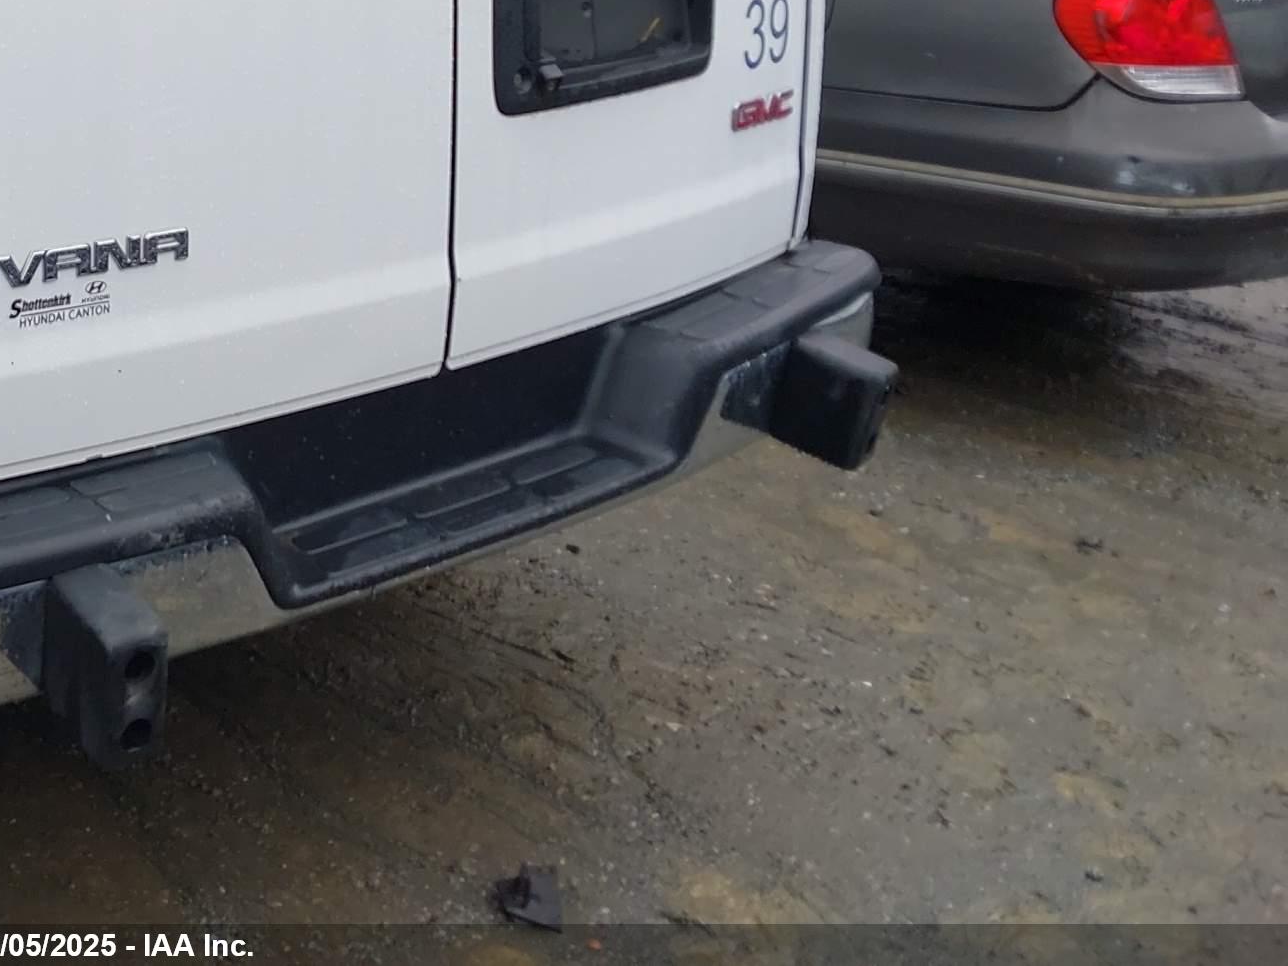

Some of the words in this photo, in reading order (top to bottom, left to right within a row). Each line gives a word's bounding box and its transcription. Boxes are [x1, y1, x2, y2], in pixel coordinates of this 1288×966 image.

[731, 89, 794, 132] GMC
[9, 293, 72, 319] Shottenkirk
[19, 312, 66, 328] HYUNDAI
[68, 303, 111, 321] CANTON
